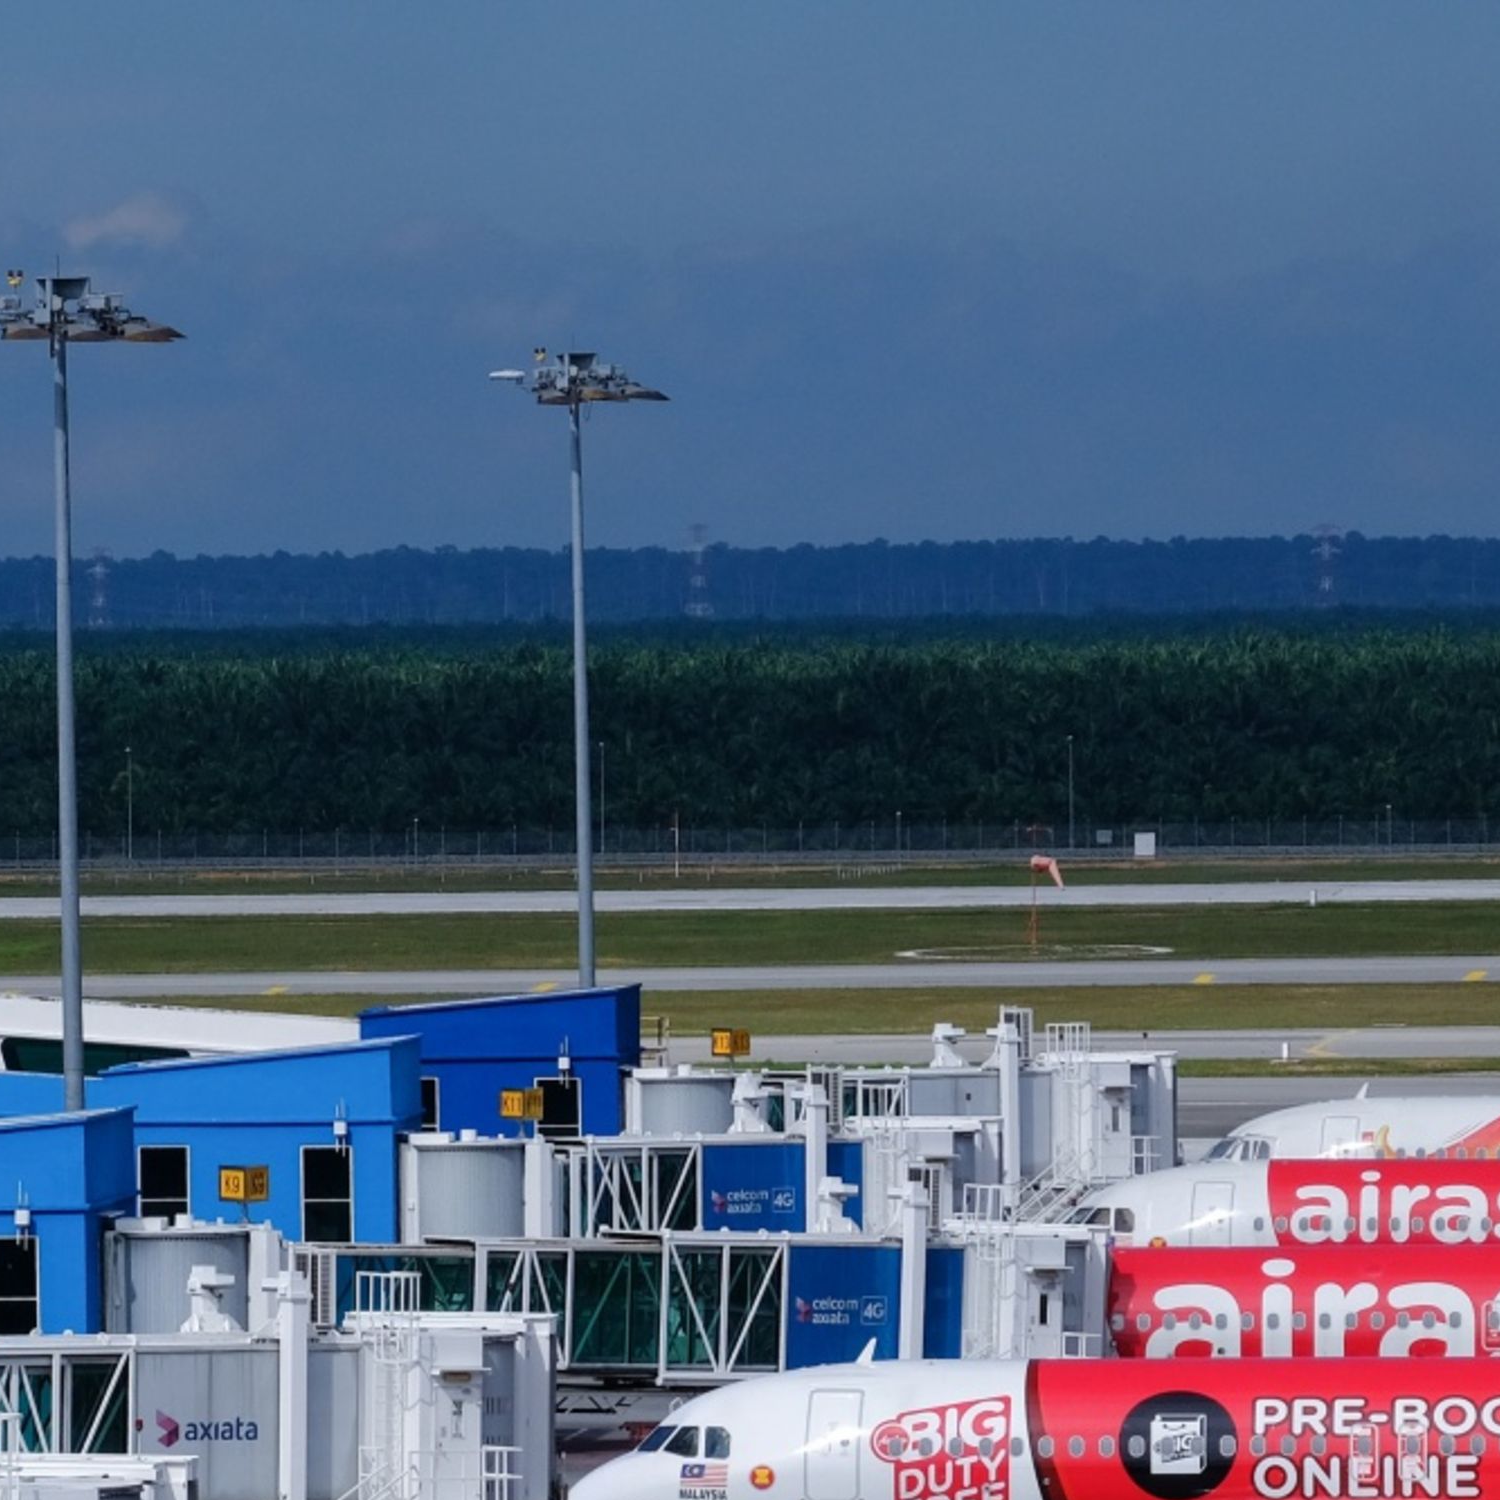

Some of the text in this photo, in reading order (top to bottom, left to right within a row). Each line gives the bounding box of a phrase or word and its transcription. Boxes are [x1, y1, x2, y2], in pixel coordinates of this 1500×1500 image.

[224, 1173, 240, 1195] K9
[184, 1416, 258, 1441] axiata
[900, 1401, 1007, 1463] BIG
[899, 1449, 1006, 1500] DUTY
[1254, 1455, 1481, 1498] ONLINE
[679, 1489, 728, 1500] MALAYSIA
